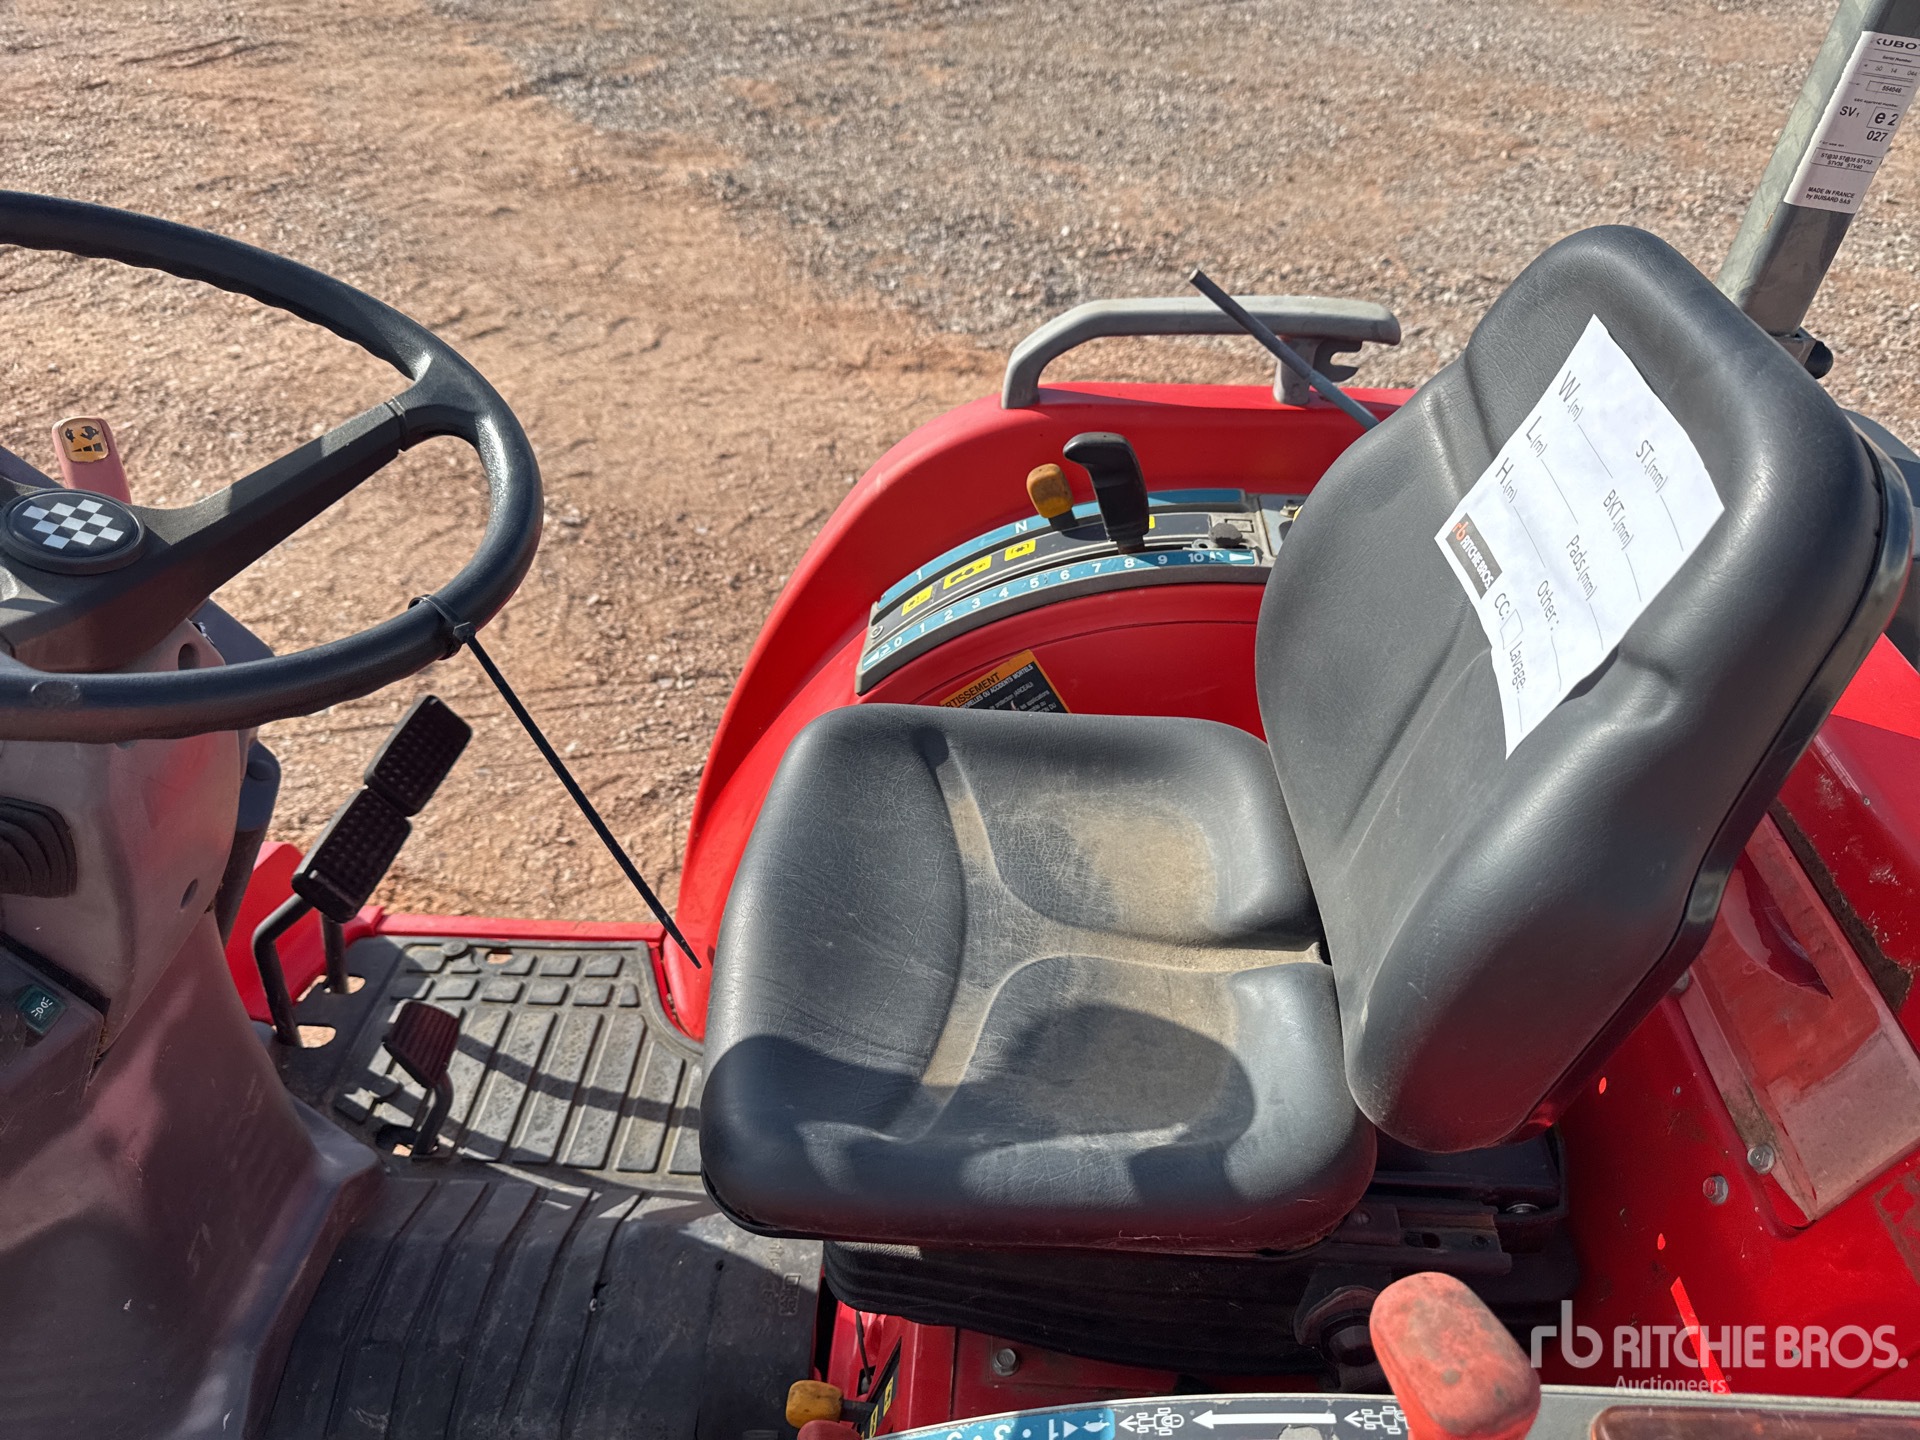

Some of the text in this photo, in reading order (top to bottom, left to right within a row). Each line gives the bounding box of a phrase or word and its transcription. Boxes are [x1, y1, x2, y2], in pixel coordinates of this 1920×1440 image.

[1876, 38, 1920, 50] KUBO
[1866, 130, 1888, 142] 027
[1808, 186, 1824, 194] MADE
[1832, 190, 1855, 198] FRANCE
[1813, 194, 1838, 203] BUISARD
[1015, 520, 1028, 534] N
[1460, 534, 1484, 568] RITCHIE
[894, 552, 1204, 647] 0 1 2 3 4 5 6 7 8 9 10
